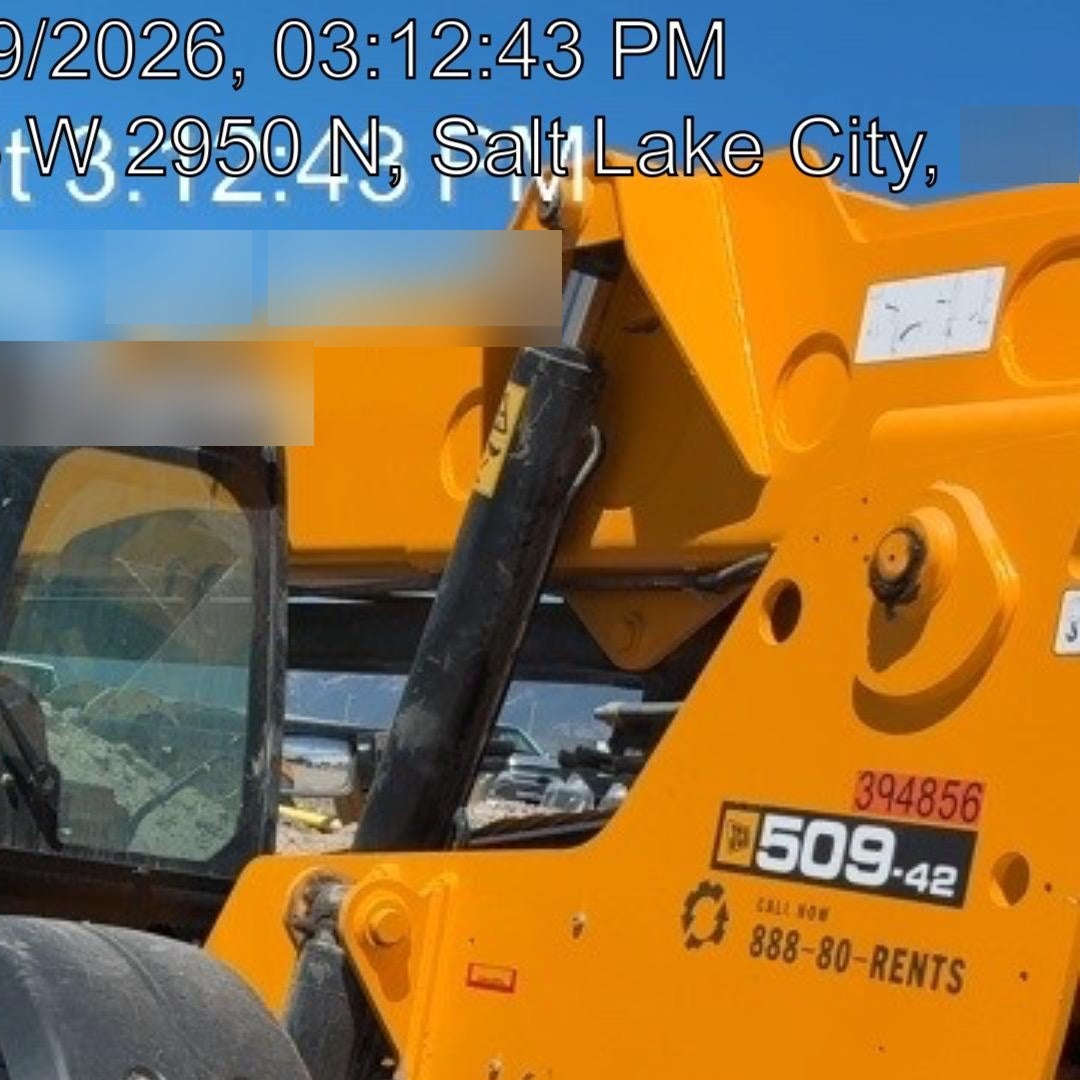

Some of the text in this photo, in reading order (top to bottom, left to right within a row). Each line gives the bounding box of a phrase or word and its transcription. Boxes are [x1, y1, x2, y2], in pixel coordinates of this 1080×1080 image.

[855, 770, 983, 823] 394856
[756, 898, 831, 923] CALL NOW
[749, 924, 967, 995] 888-80-RENTS
